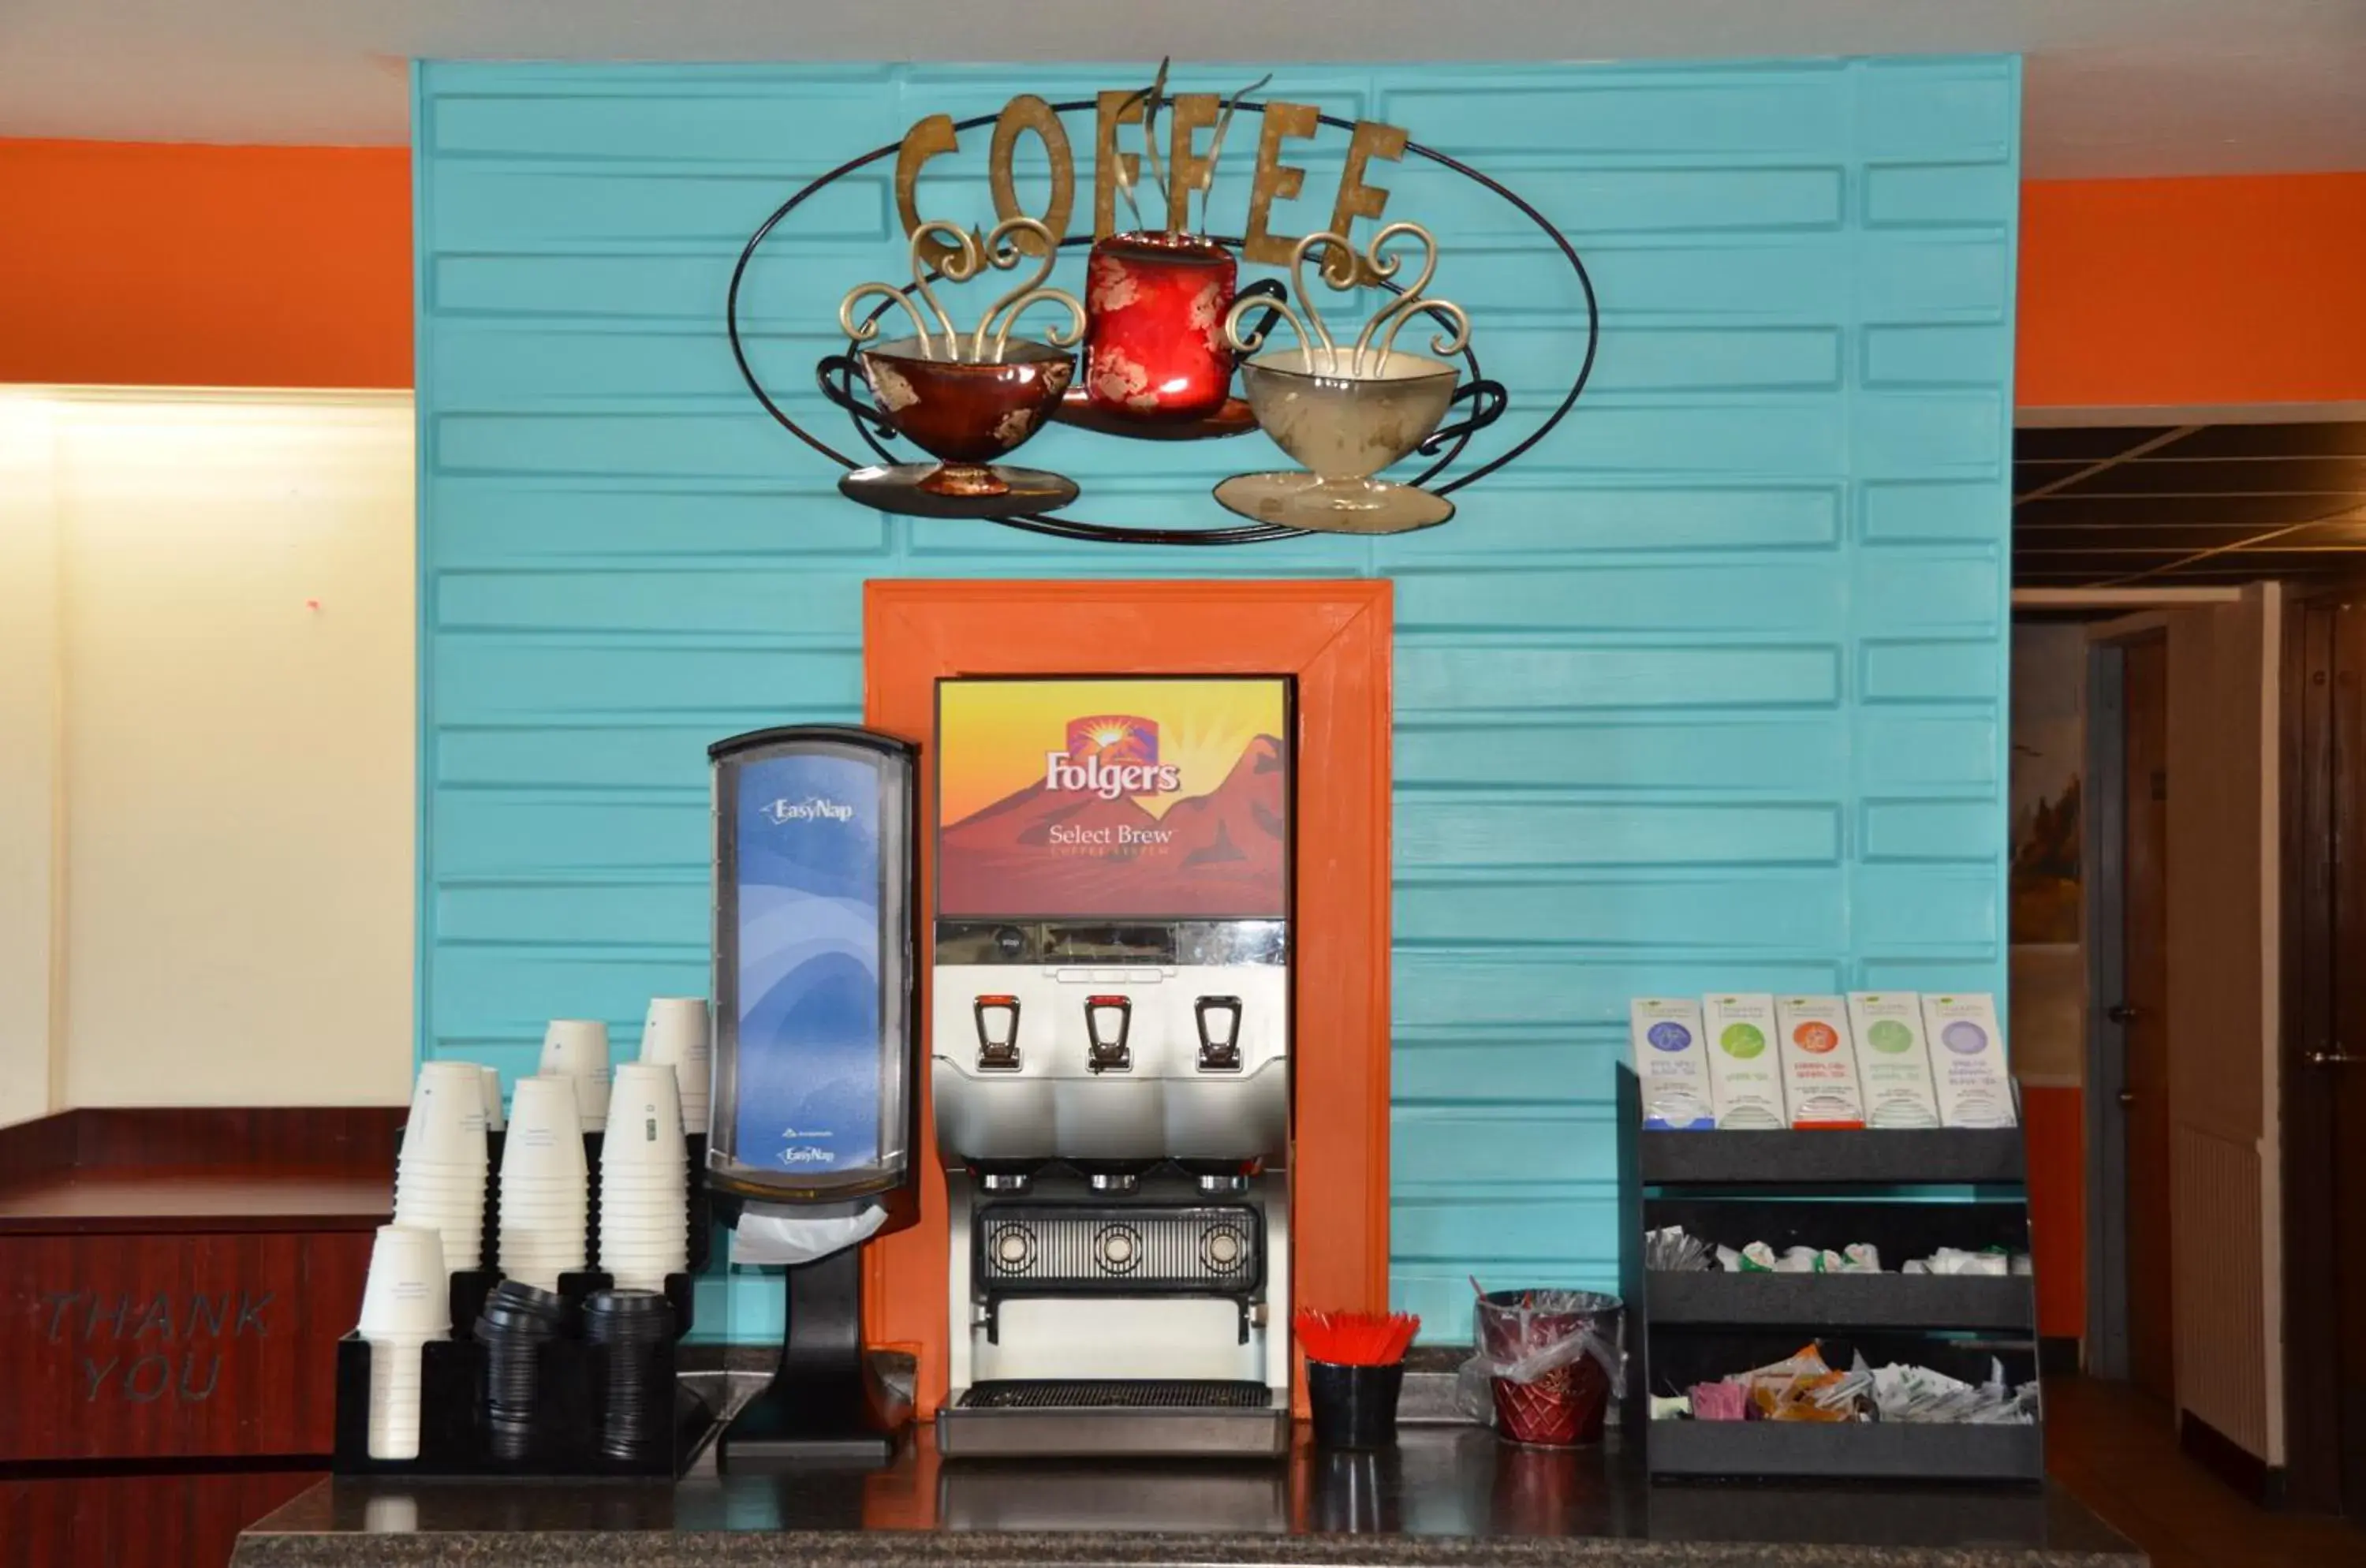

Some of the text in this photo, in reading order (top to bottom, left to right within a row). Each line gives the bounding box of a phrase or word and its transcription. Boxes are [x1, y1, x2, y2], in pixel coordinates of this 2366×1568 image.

[896, 91, 1409, 286] COFFEE
[1046, 752, 1180, 799] Folgers
[776, 798, 853, 823] EasyNap
[1049, 824, 1173, 844] Select Brew
[786, 1147, 834, 1163] EasyNap
[43, 1290, 276, 1342] THANK
[84, 1351, 224, 1402] YOU
